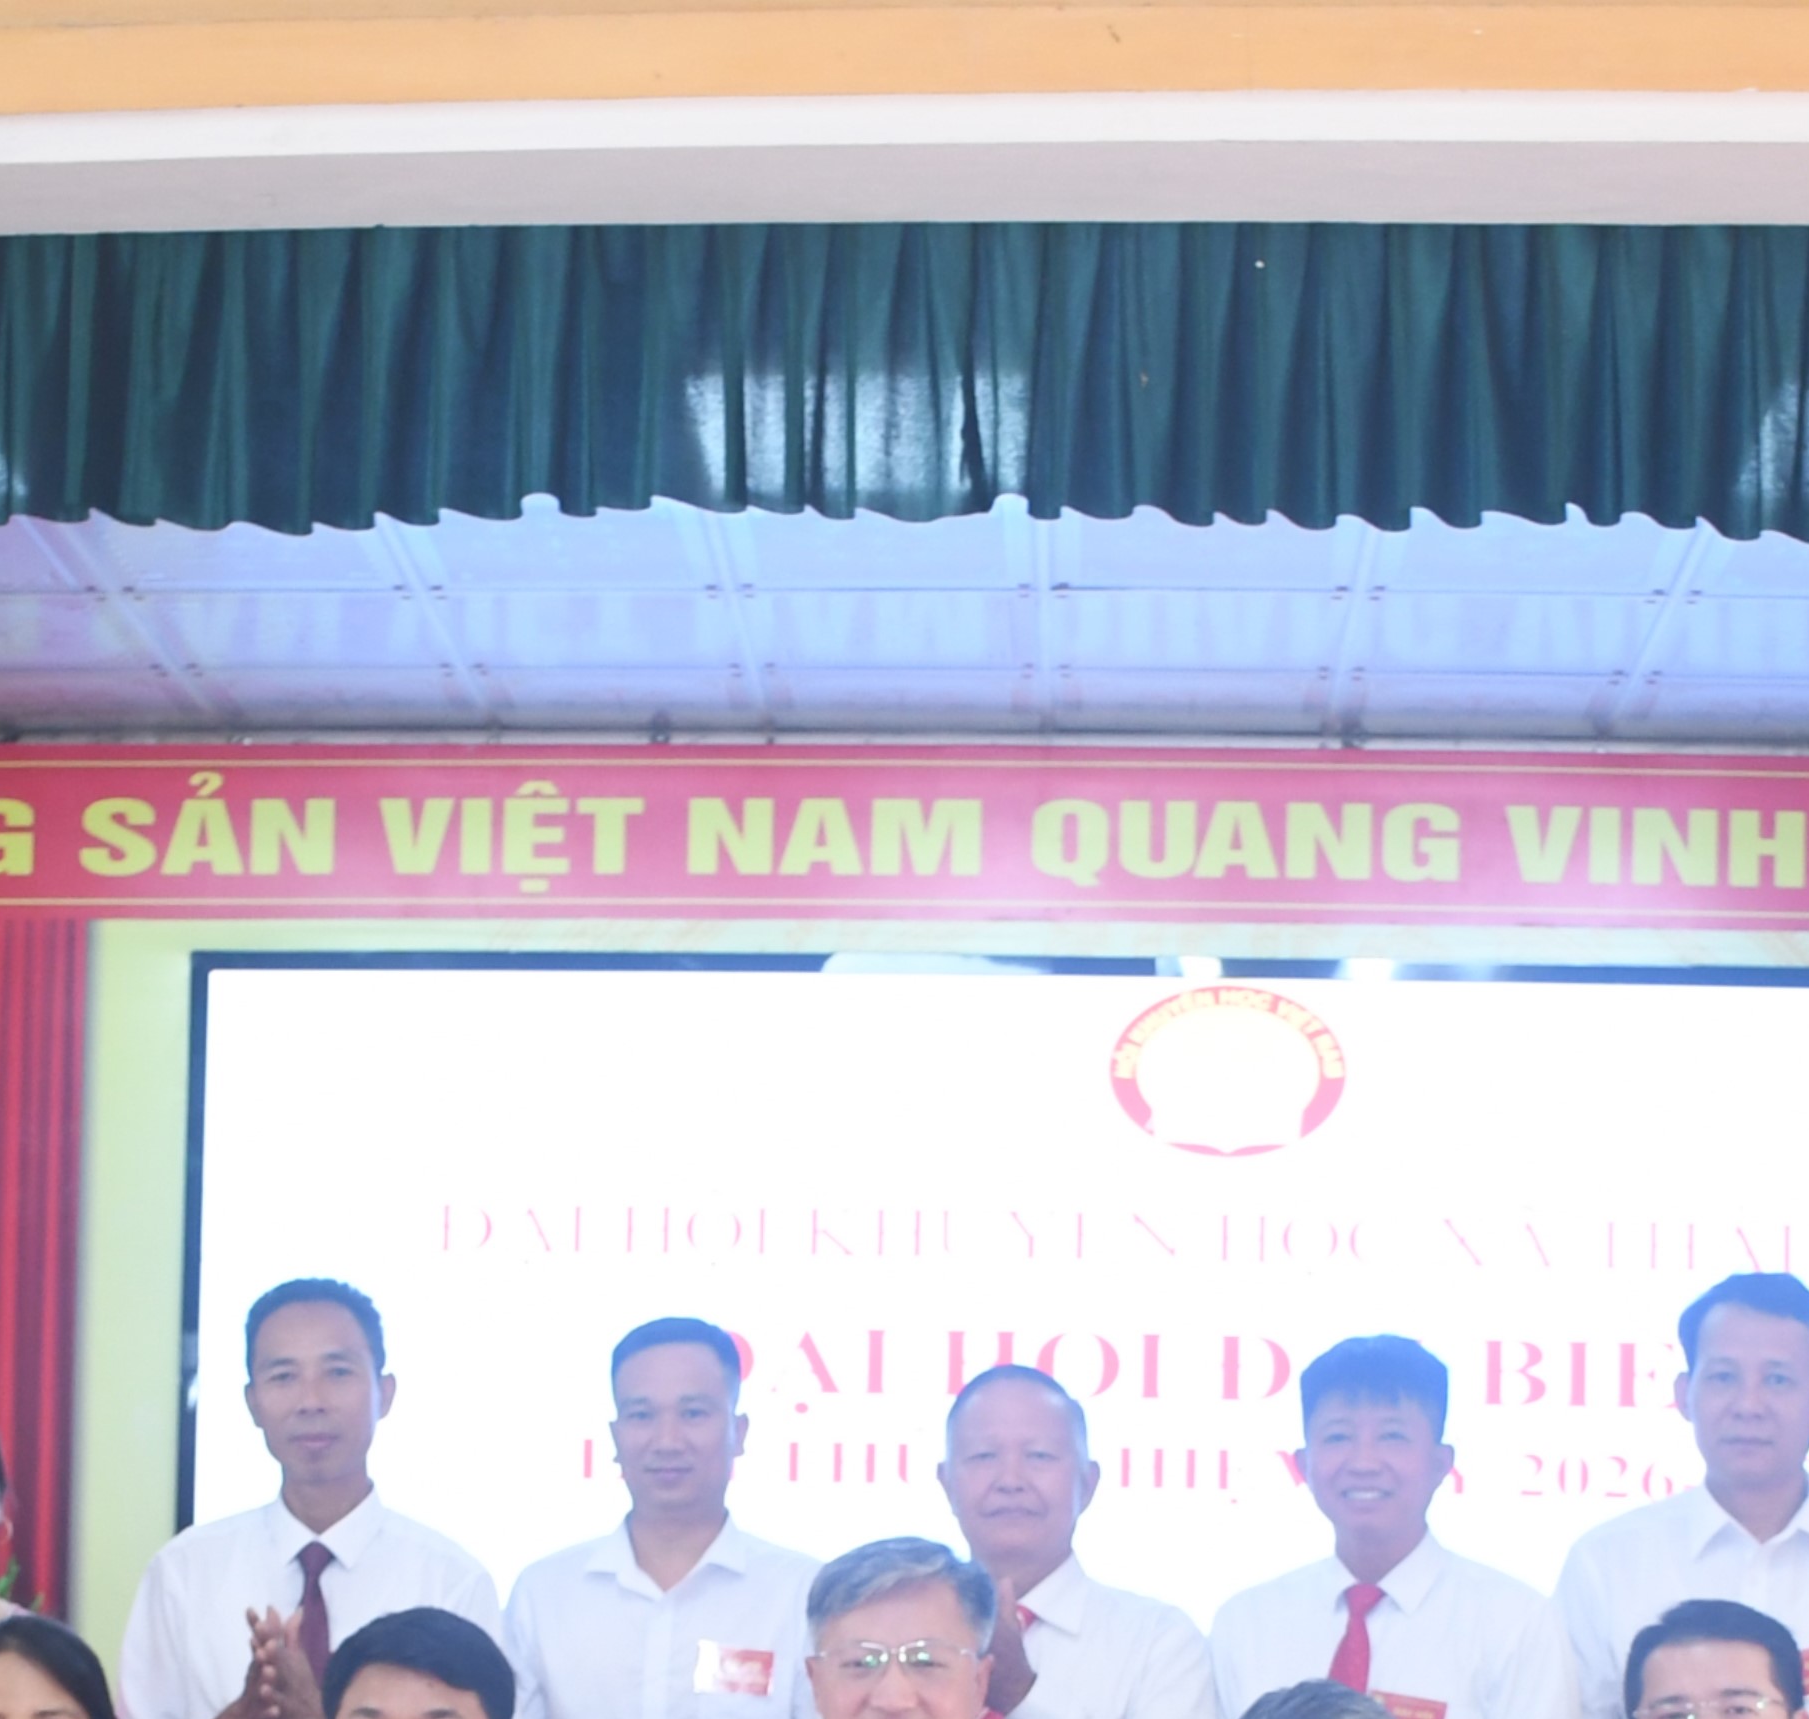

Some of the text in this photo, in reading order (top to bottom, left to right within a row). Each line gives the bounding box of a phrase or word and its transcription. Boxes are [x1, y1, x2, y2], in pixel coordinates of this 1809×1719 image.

[80, 771, 334, 875] SẢN
[382, 780, 644, 893] VIỆT
[689, 798, 981, 878] NAM
[1031, 797, 1462, 882] QUANG
[1510, 805, 1806, 889] VINH
